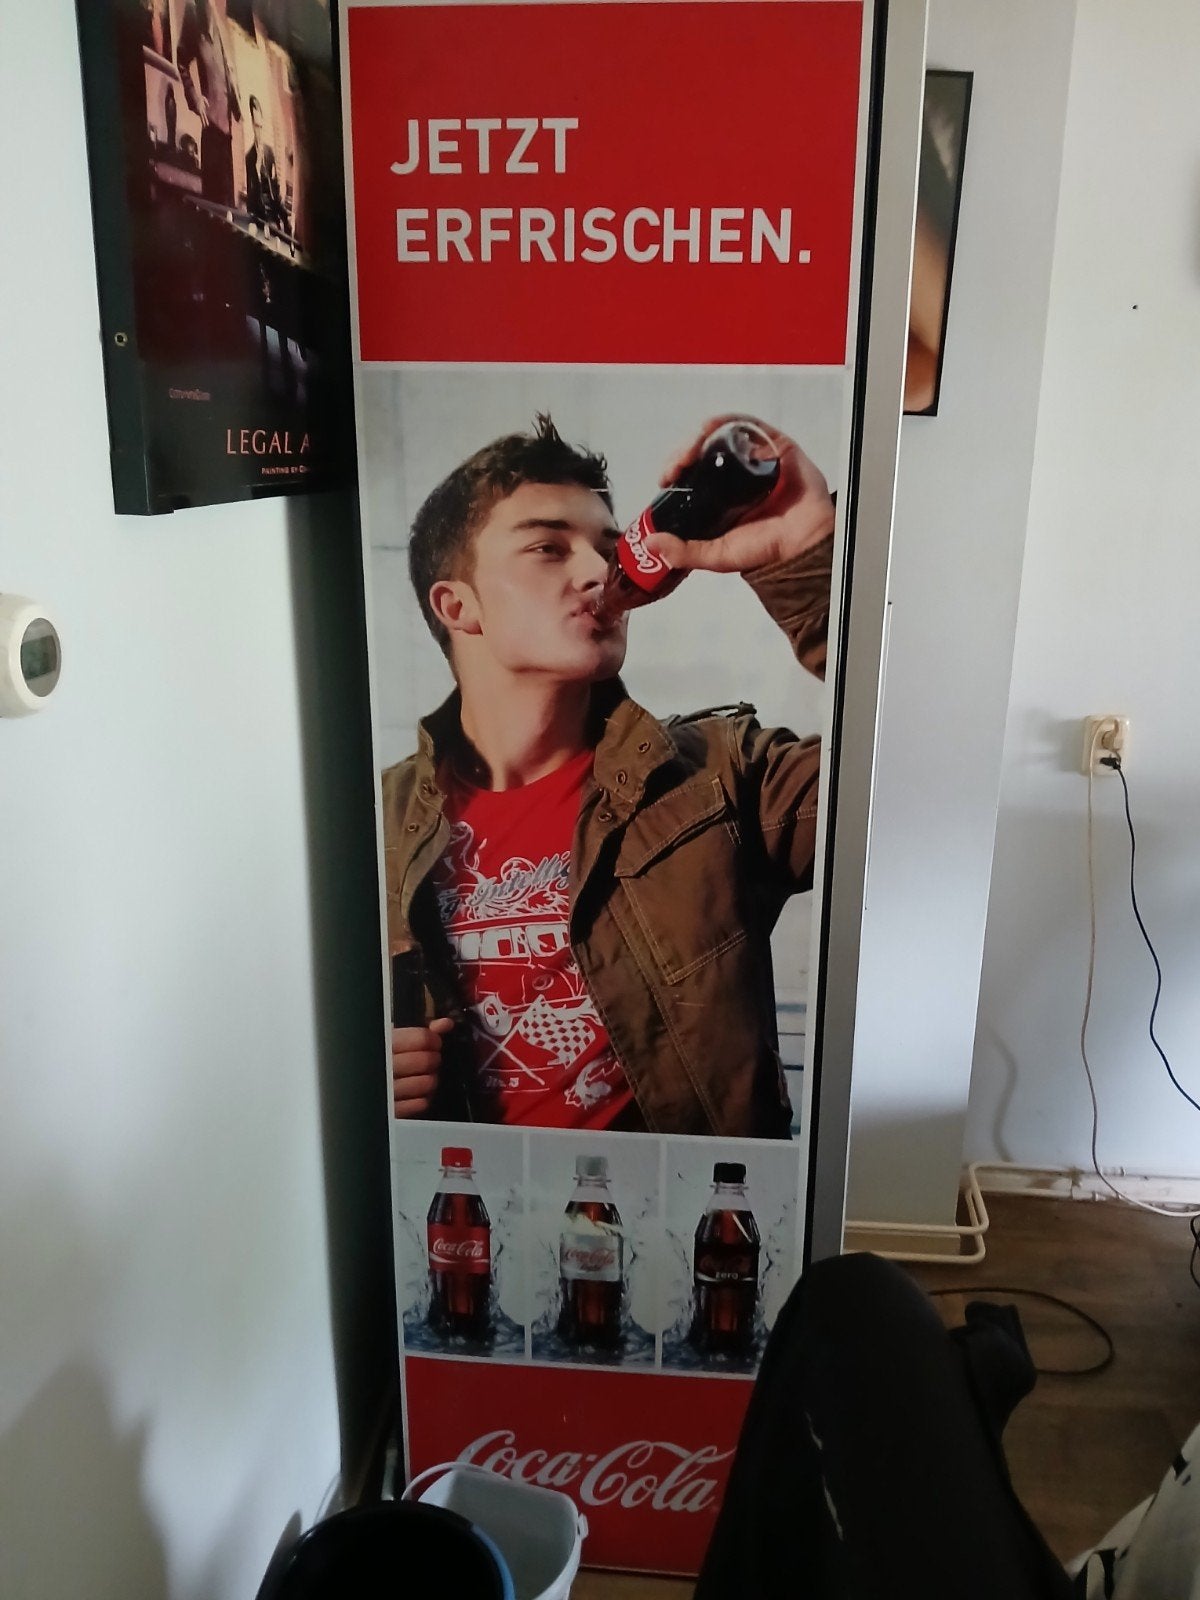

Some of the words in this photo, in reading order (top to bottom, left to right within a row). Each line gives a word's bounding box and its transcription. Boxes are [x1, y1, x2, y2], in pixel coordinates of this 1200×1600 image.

[390, 118, 579, 174] JETZT
[396, 207, 811, 264] ERFRISCHEN.
[226, 429, 293, 454] LEGAL
[261, 466, 290, 475] PAINTING
